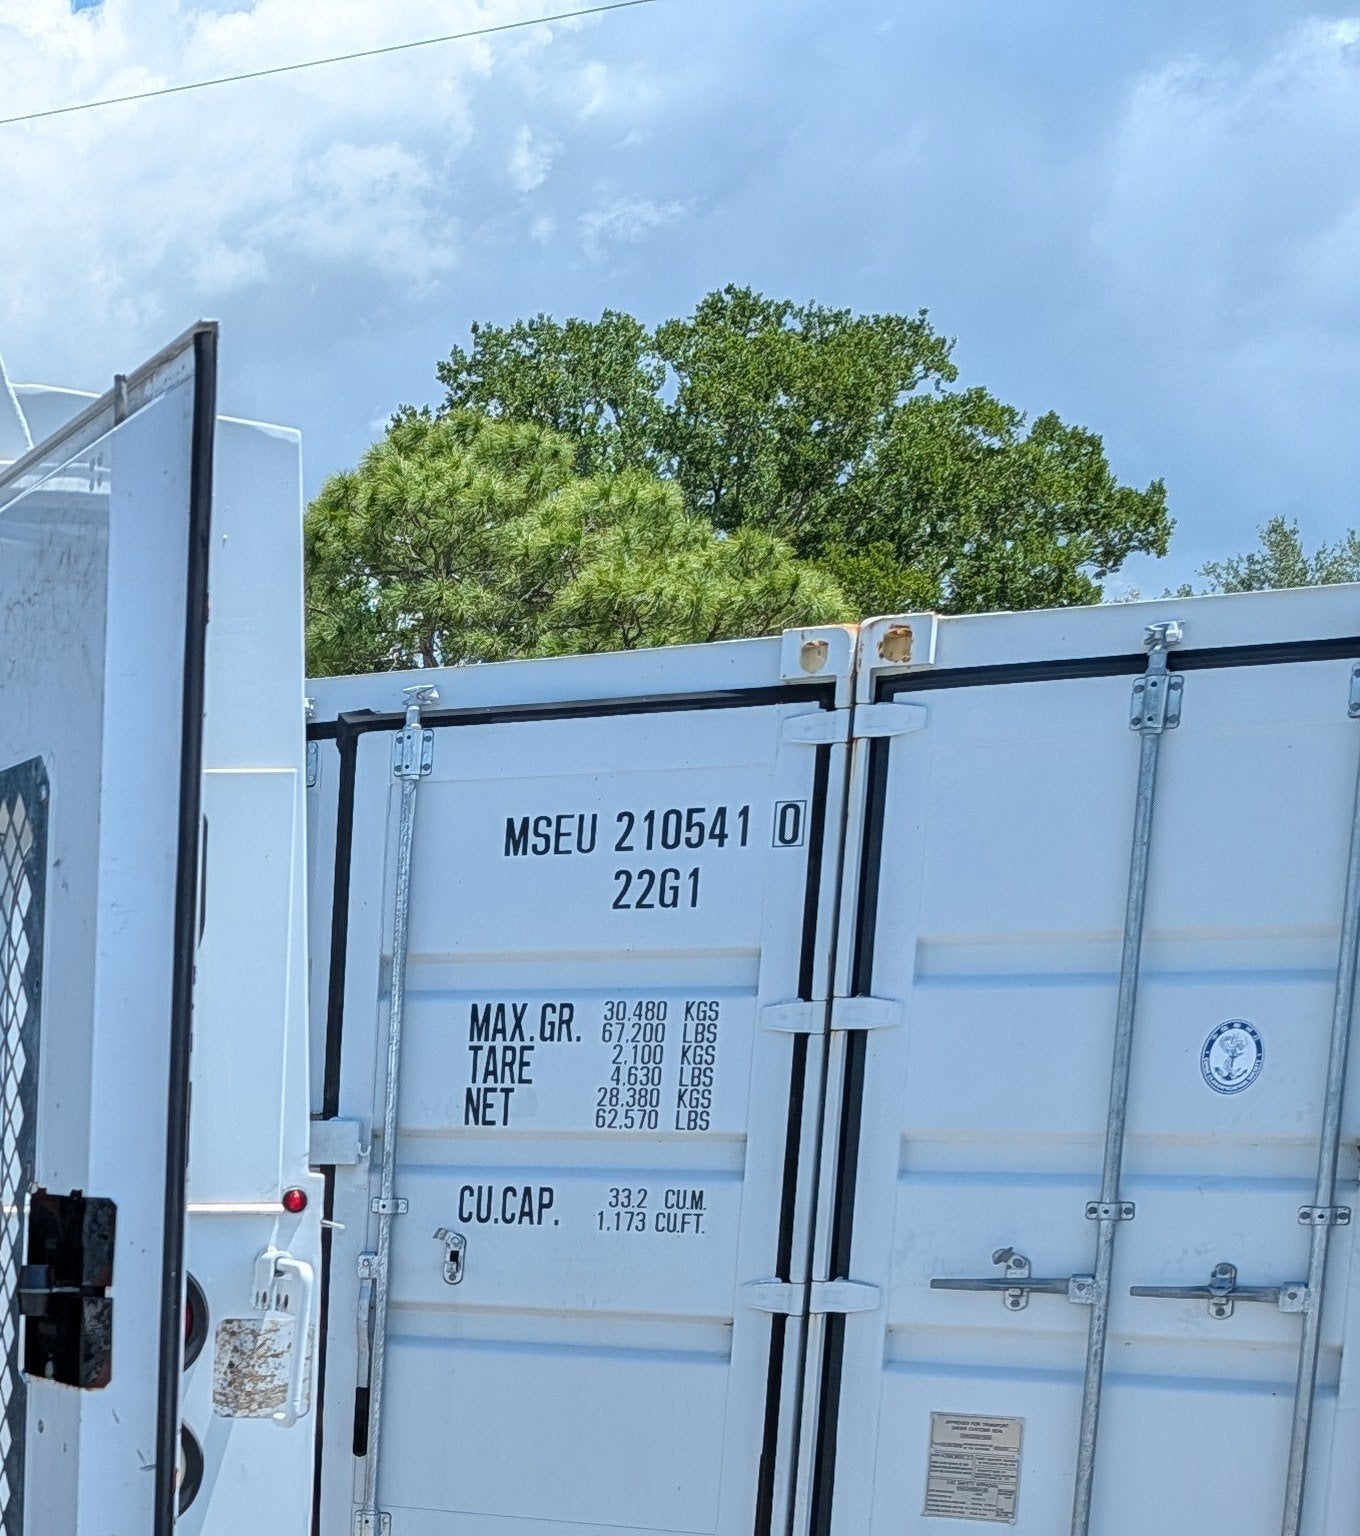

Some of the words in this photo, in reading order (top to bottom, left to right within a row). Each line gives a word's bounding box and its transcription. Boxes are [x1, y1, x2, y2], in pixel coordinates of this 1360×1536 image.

[504, 813, 598, 857] MSEU
[614, 804, 750, 852] 210541
[777, 802, 801, 845] 0
[612, 867, 700, 910] 22G1
[603, 1000, 668, 1022] 30,480
[684, 1000, 720, 1022] KGS
[601, 1022, 666, 1044] 67,200
[682, 1023, 718, 1044] LBS
[468, 1045, 535, 1085] TARE
[680, 1044, 716, 1066] KGS
[679, 1066, 714, 1087] LBS
[464, 1087, 515, 1126] NET
[596, 1087, 661, 1108] 28,380
[676, 1088, 712, 1109] KGS
[595, 1108, 659, 1130] 62,570
[675, 1109, 710, 1131] LBS
[458, 1185, 560, 1226] CU.CAP.
[608, 1187, 648, 1209] 33.2
